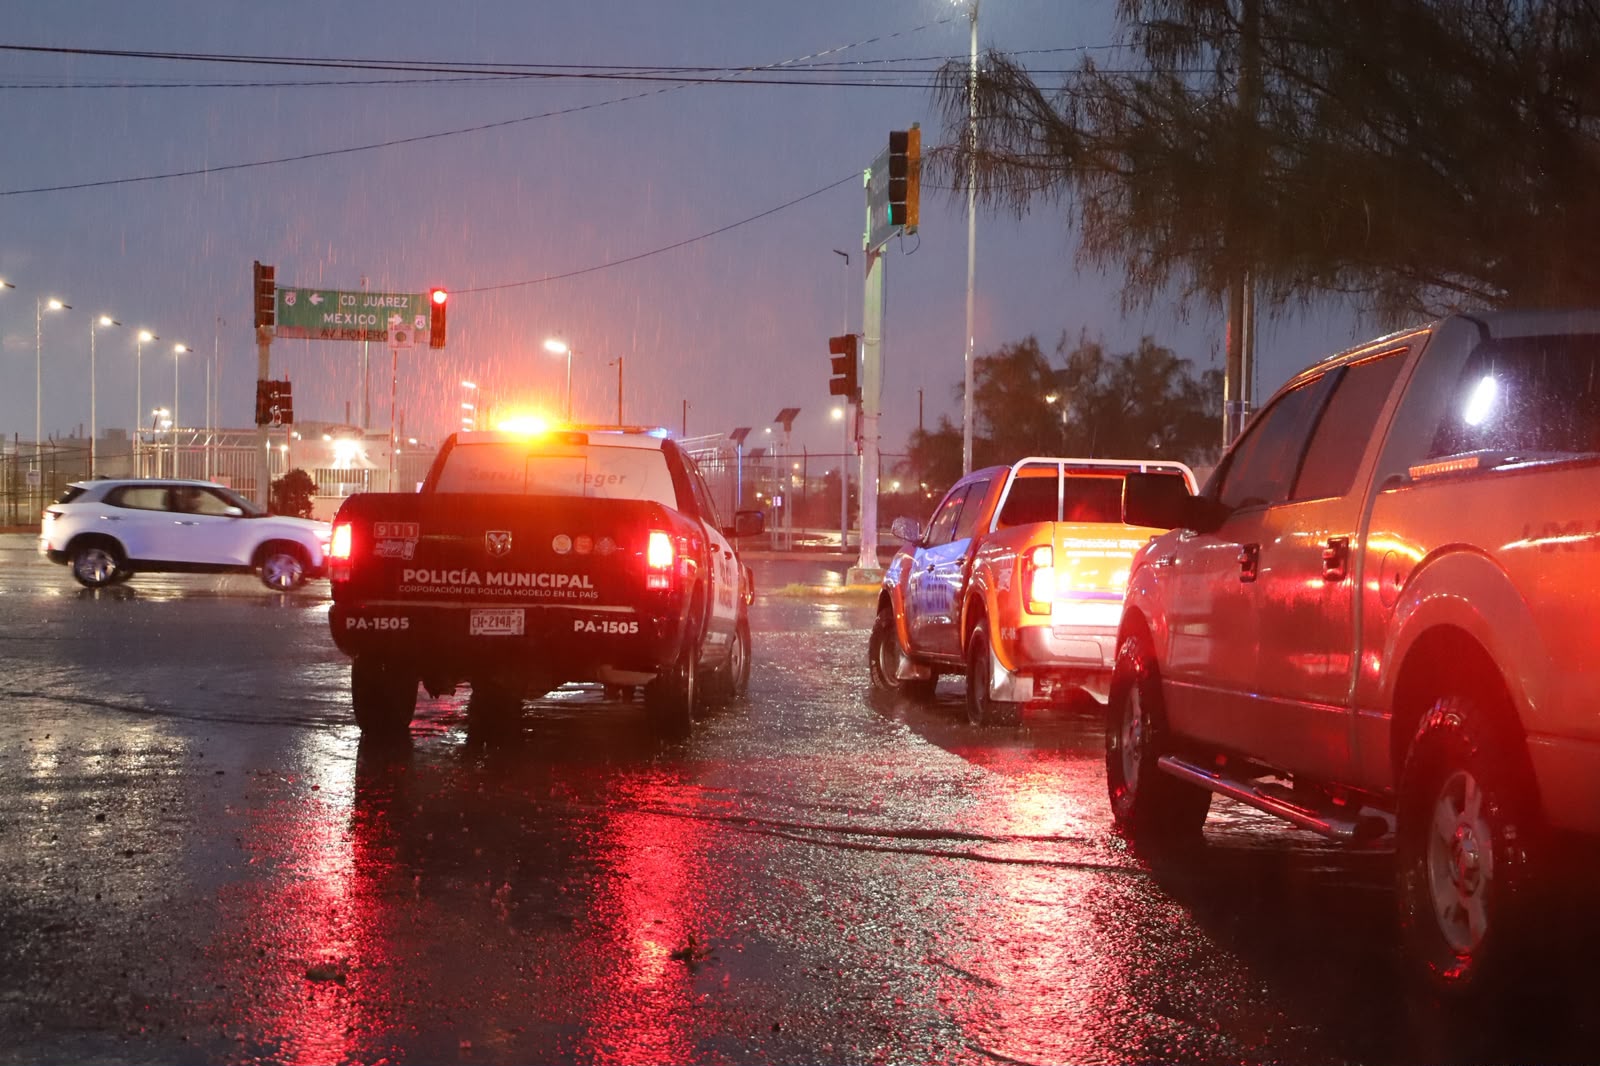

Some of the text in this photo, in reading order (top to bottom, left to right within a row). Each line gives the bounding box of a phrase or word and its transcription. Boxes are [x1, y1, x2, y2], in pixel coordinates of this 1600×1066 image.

[363, 296, 408, 308] JUAREZ
[324, 313, 376, 325] MEXICO
[378, 525, 414, 537] 911
[403, 568, 594, 589] POLICÍA MUNICIPAL
[399, 585, 462, 594] CORPORACIÓN
[478, 587, 512, 596] POLICÍA
[514, 588, 551, 597] MODELO
[567, 590, 577, 598] EL
[580, 590, 599, 599] PAÍS
[346, 617, 410, 630] PA-1505
[574, 620, 639, 634] PA-1505
